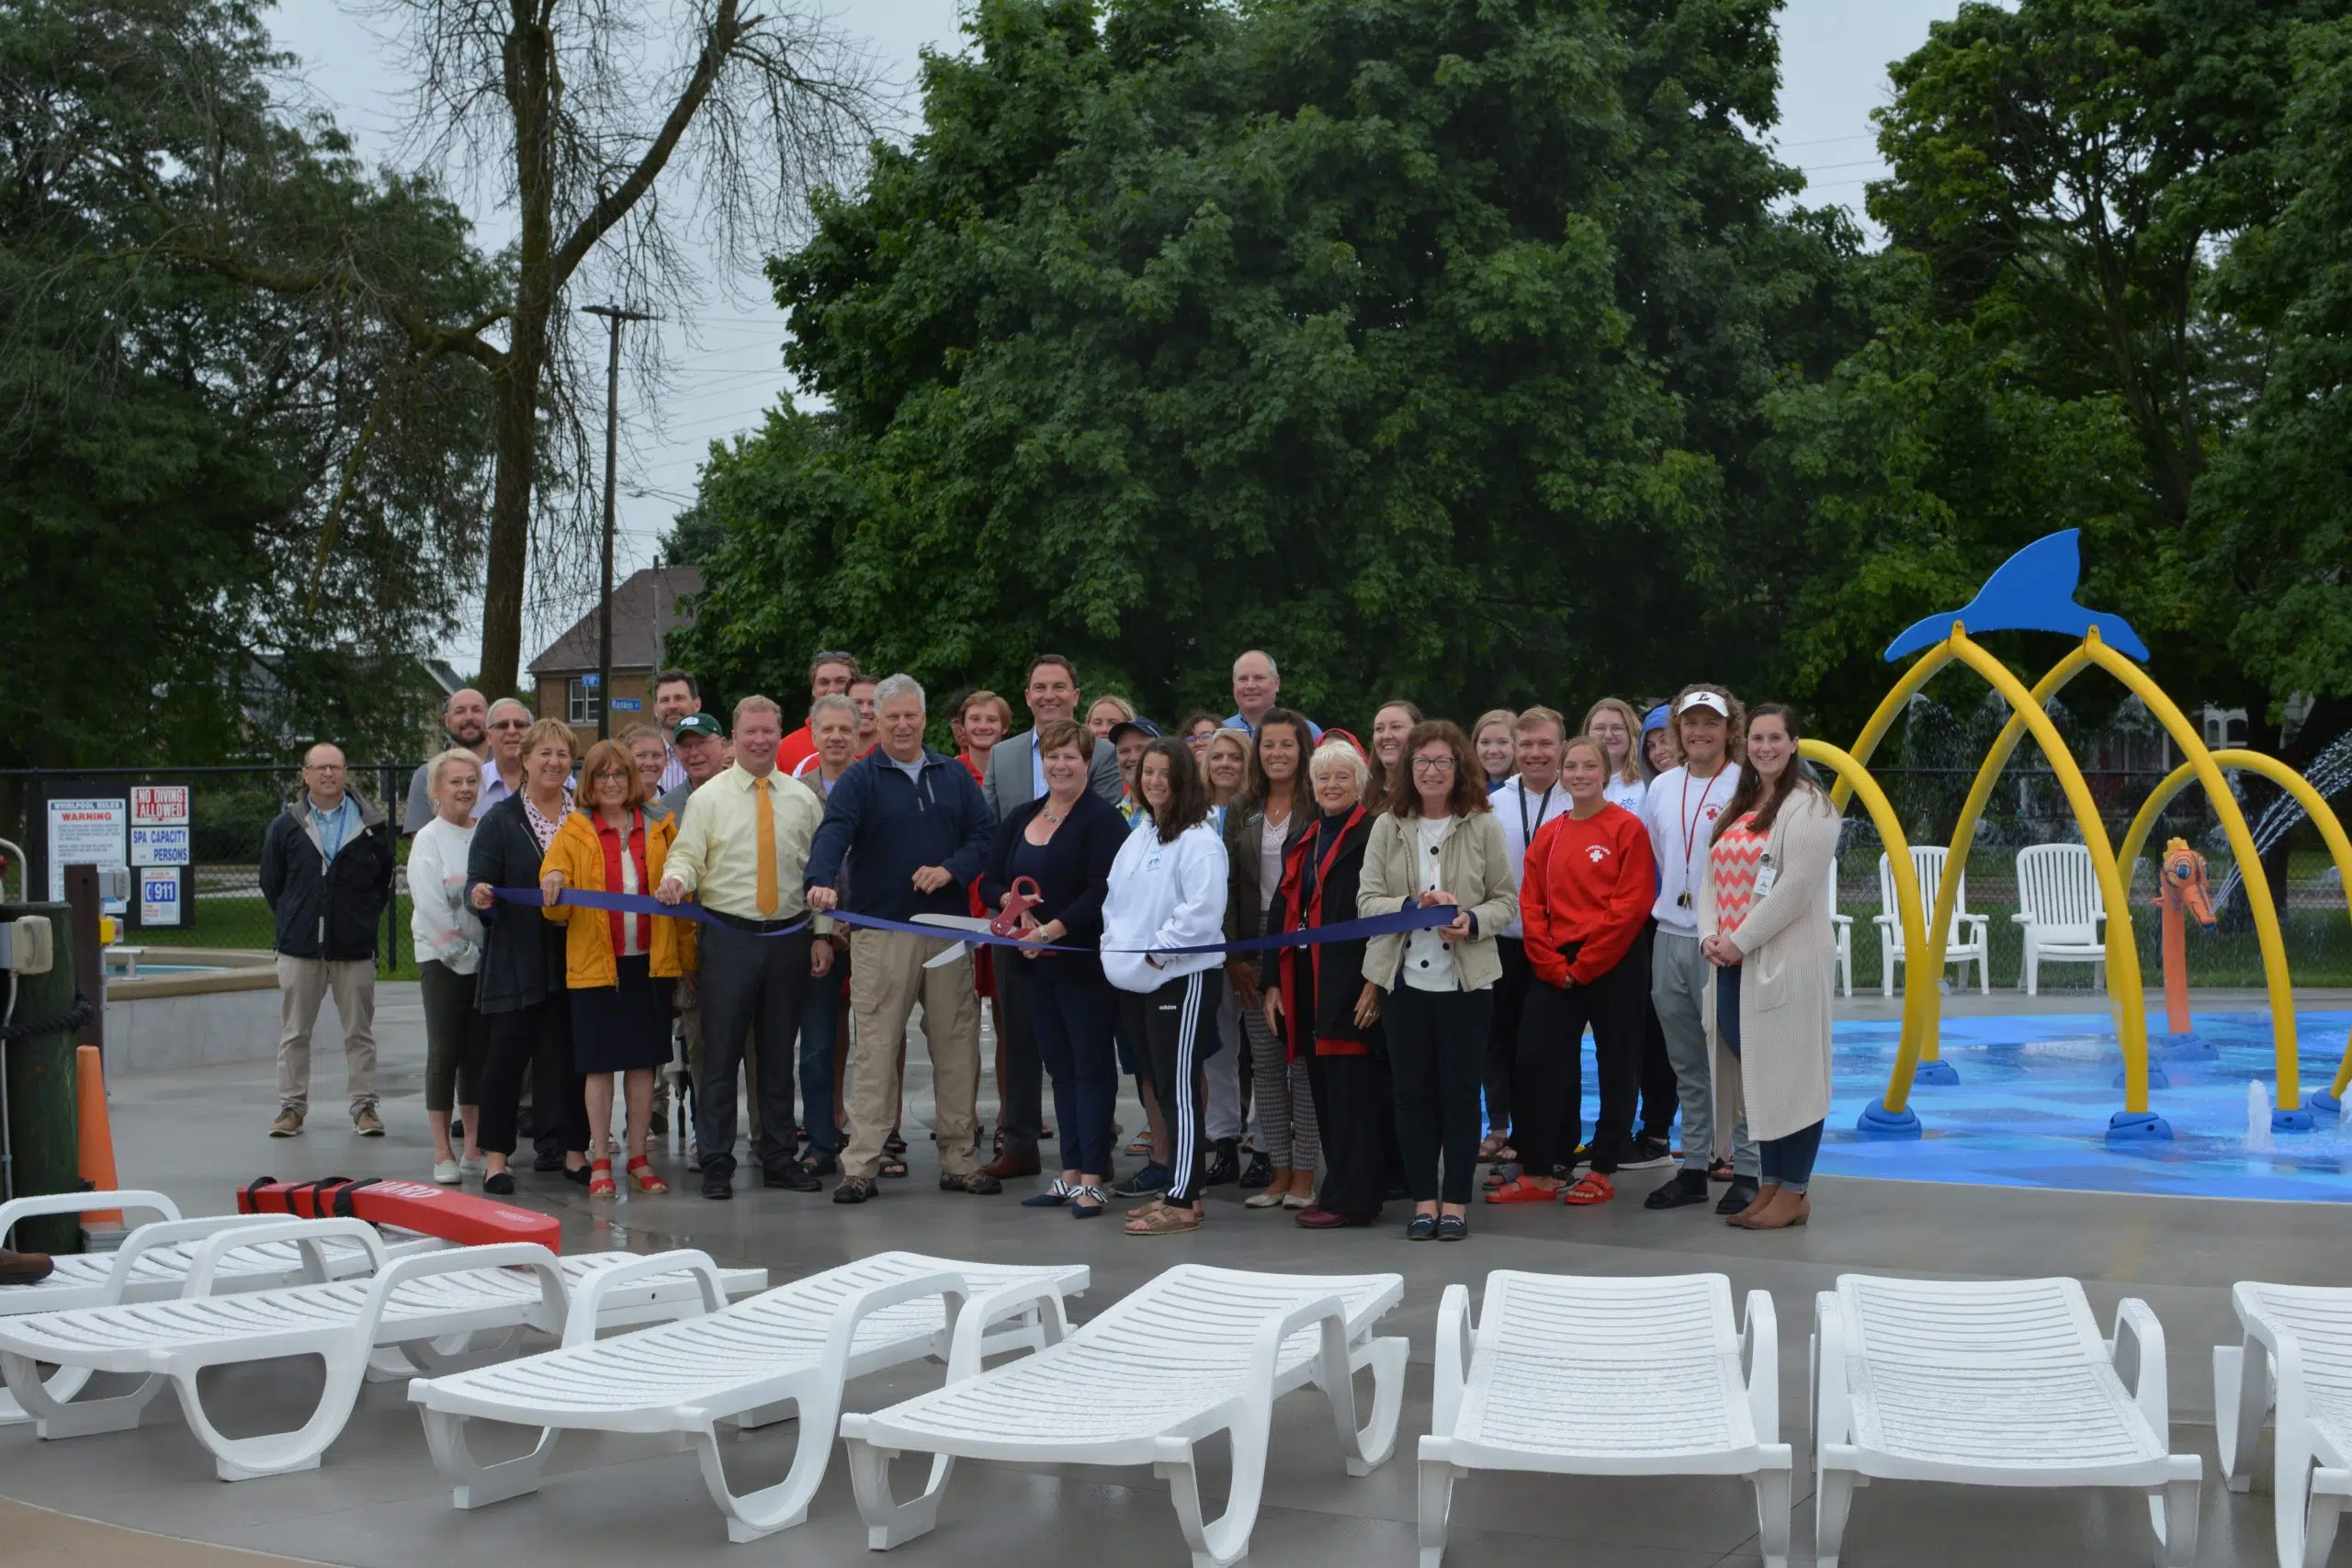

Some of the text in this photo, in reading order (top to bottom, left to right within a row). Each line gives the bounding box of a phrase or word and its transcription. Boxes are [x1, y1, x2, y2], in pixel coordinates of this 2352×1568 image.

[612, 700, 633, 710] Rankin
[139, 789, 183, 803] NO DIVING
[62, 812, 112, 821] WARNING
[140, 803, 183, 817] ALLOWED
[133, 830, 186, 843] SPA CAPACITY
[154, 848, 187, 862] PERSONS
[154, 883, 174, 900] 911
[357, 1181, 444, 1198] UARD
